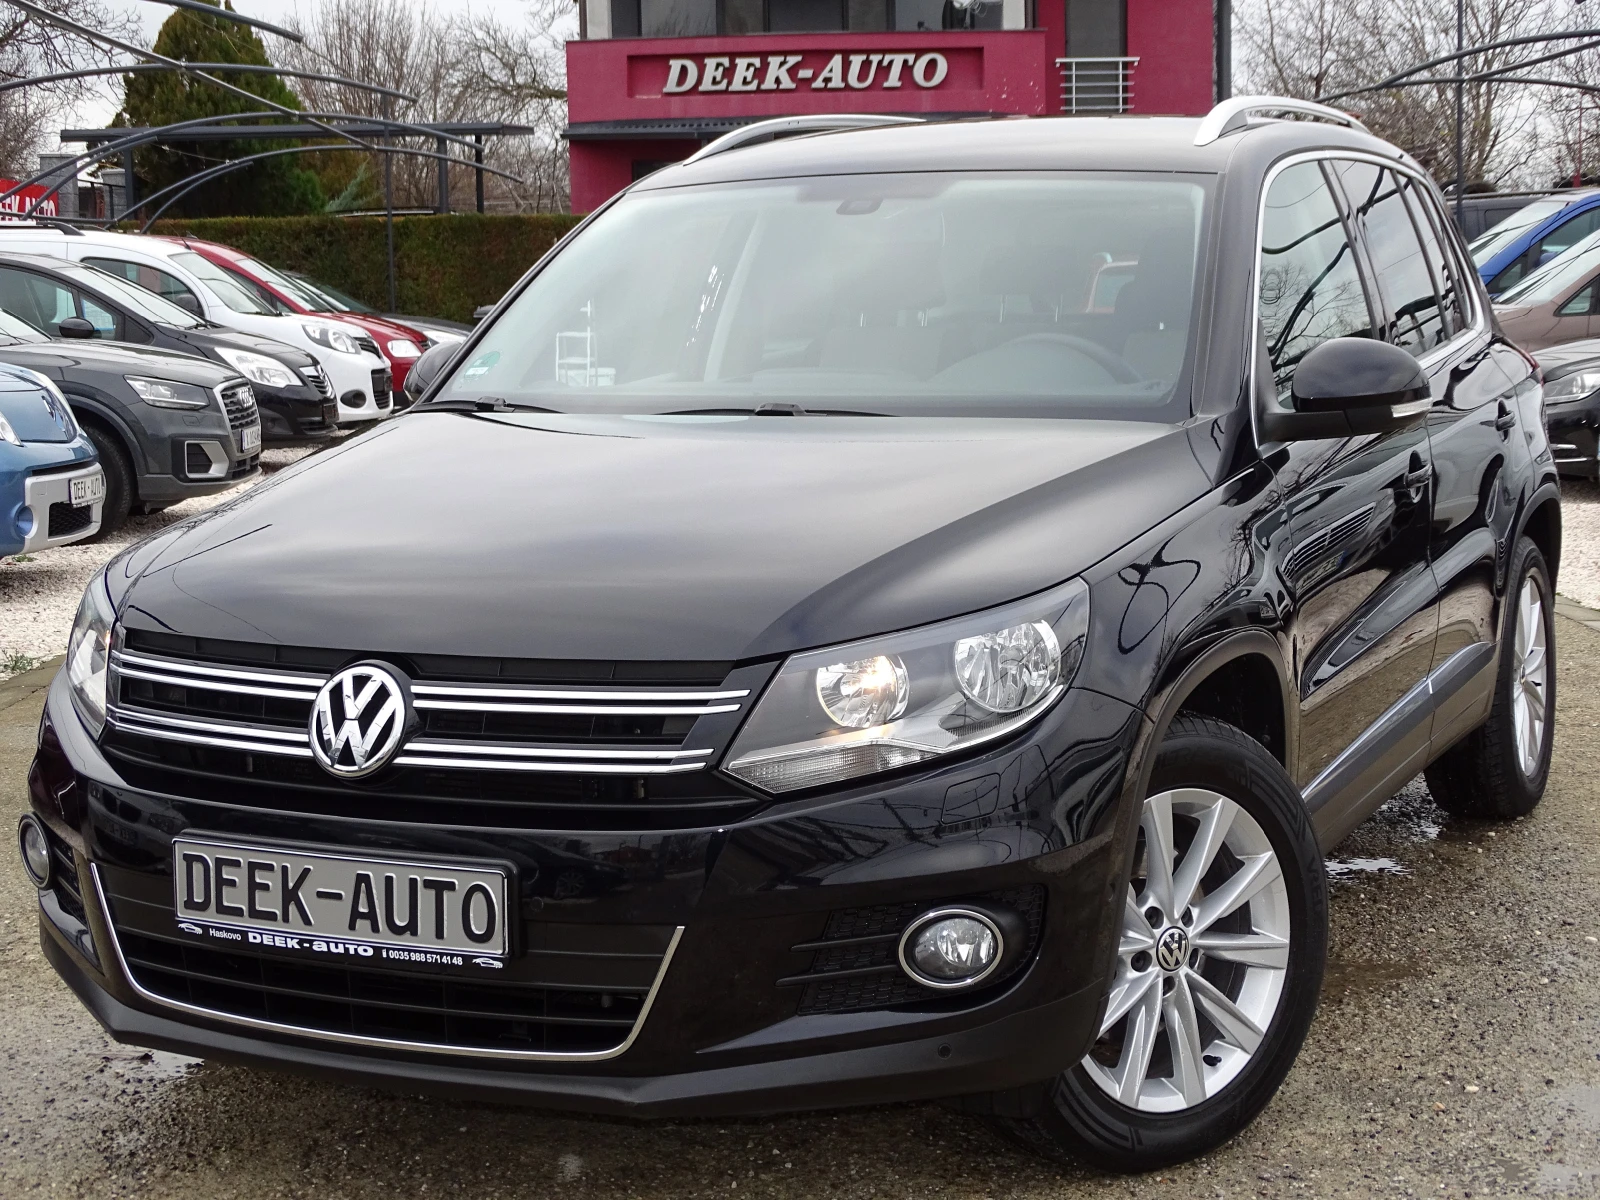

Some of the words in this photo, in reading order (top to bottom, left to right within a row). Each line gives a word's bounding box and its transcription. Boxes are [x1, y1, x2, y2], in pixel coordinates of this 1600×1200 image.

[662, 52, 949, 94] DEEK-AUTO
[182, 851, 498, 944] DEEK-AUTO
[209, 927, 242, 941] Haskovo
[389, 950, 409, 960] 0035
[410, 952, 426, 961] 988
